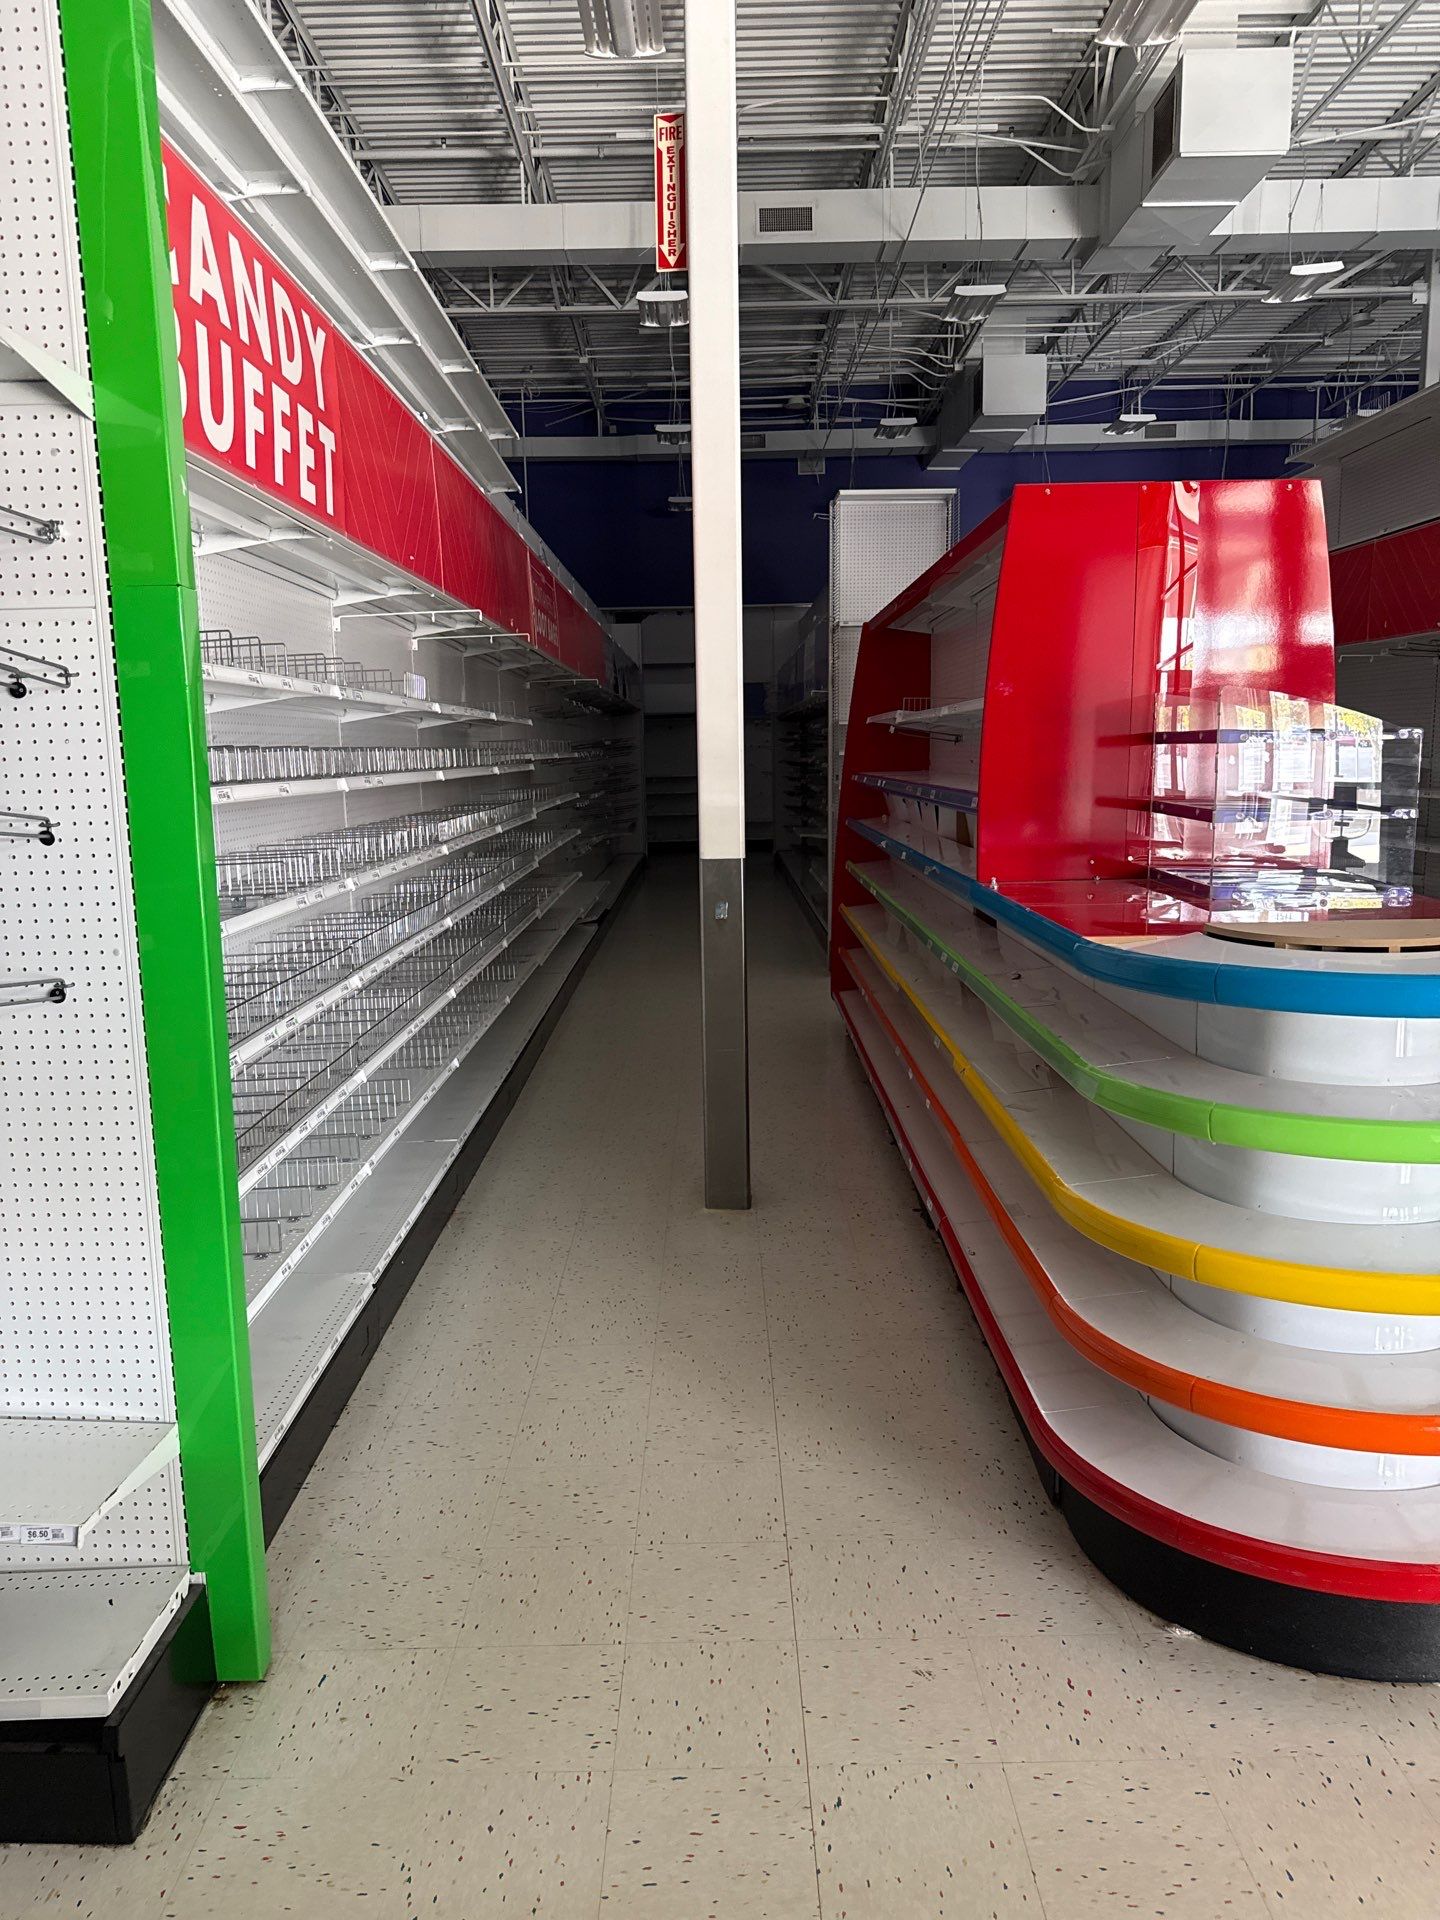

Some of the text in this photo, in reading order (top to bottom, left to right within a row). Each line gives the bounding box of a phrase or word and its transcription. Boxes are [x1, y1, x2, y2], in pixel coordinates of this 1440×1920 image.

[658, 125, 683, 142] FIRE
[666, 146, 677, 257] EXTINGUISHER
[162, 160, 327, 412] ANDY
[174, 307, 336, 517] UFFET
[27, 1530, 49, 1539] $6.50
